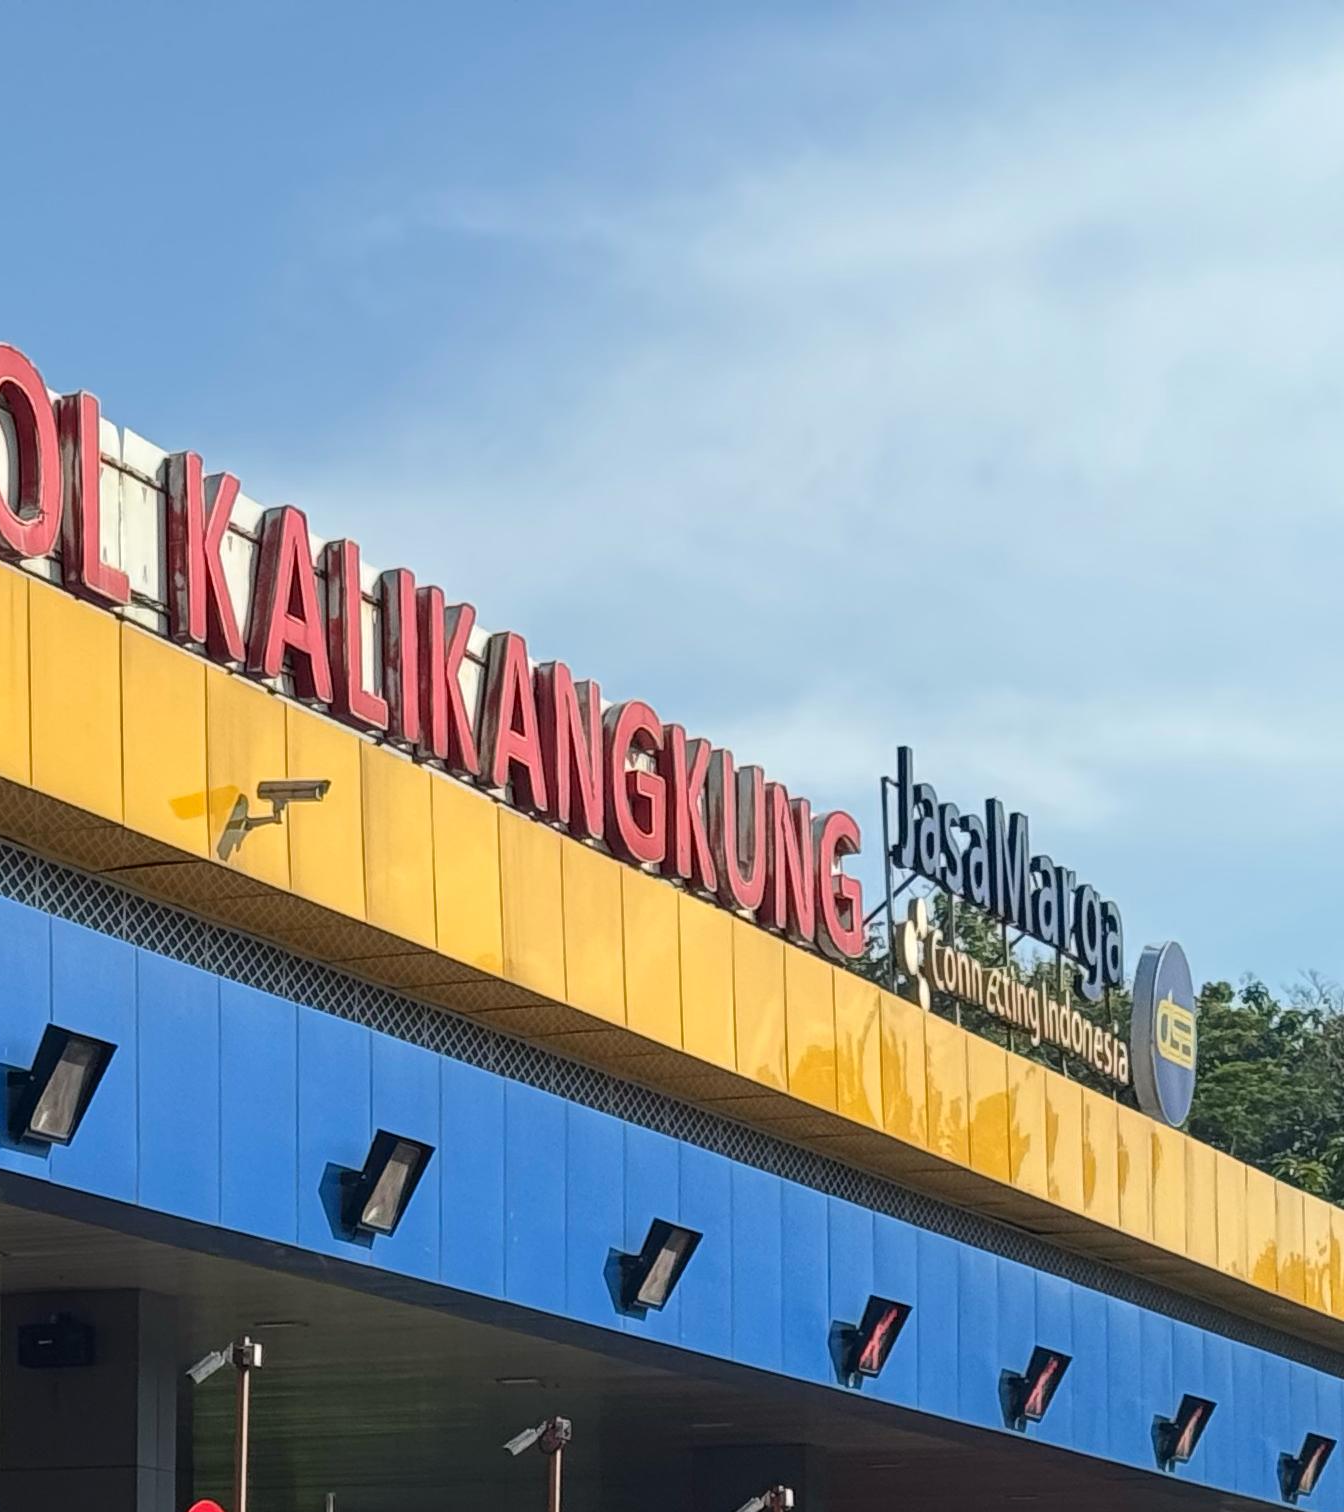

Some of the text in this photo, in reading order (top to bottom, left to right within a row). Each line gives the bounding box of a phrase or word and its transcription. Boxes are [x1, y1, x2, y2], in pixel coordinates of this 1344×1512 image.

[168, 450, 864, 958] KALIKANGKUNG
[891, 745, 1125, 1001] JasaMarga
[1042, 981, 1130, 1086] Indonesia
